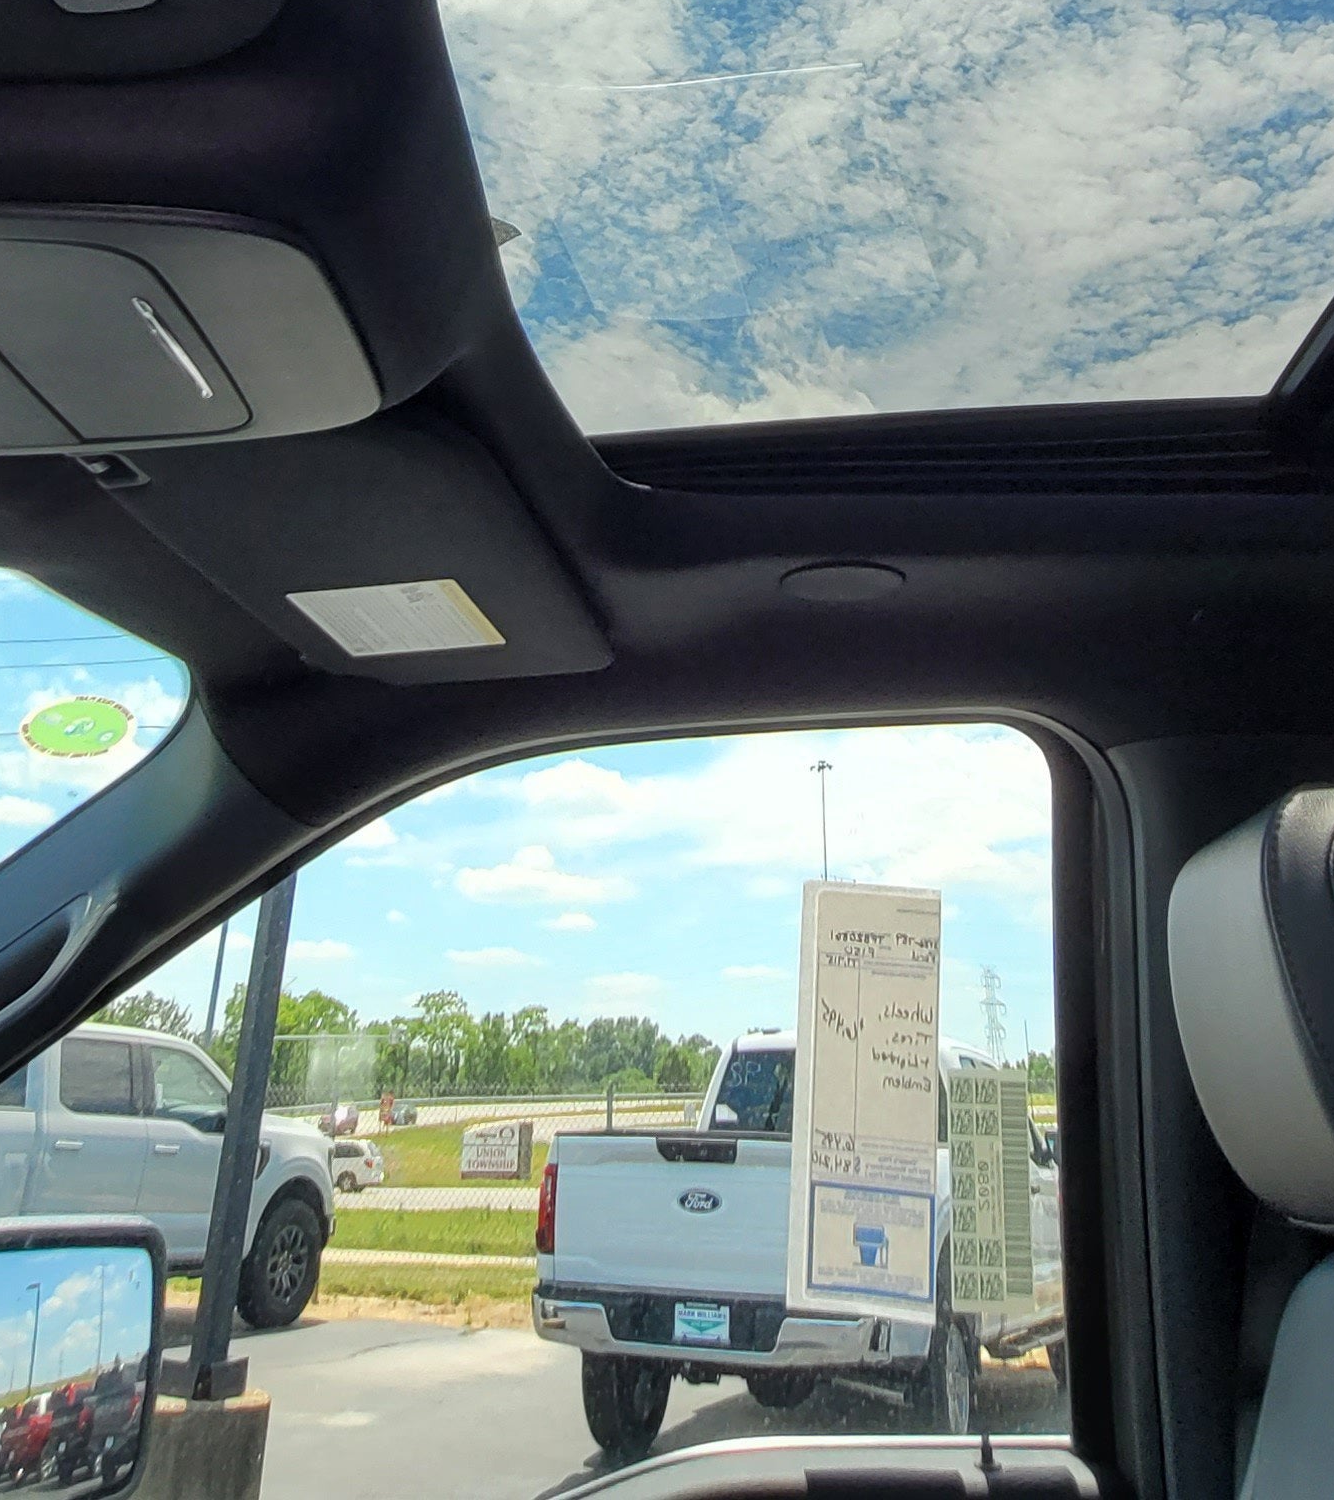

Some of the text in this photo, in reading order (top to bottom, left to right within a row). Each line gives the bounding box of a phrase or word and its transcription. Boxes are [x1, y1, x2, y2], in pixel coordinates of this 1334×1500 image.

[476, 1146, 507, 1157] UNION
[467, 1159, 515, 1169] TOWNSHIP
[684, 1191, 714, 1210] Ford
